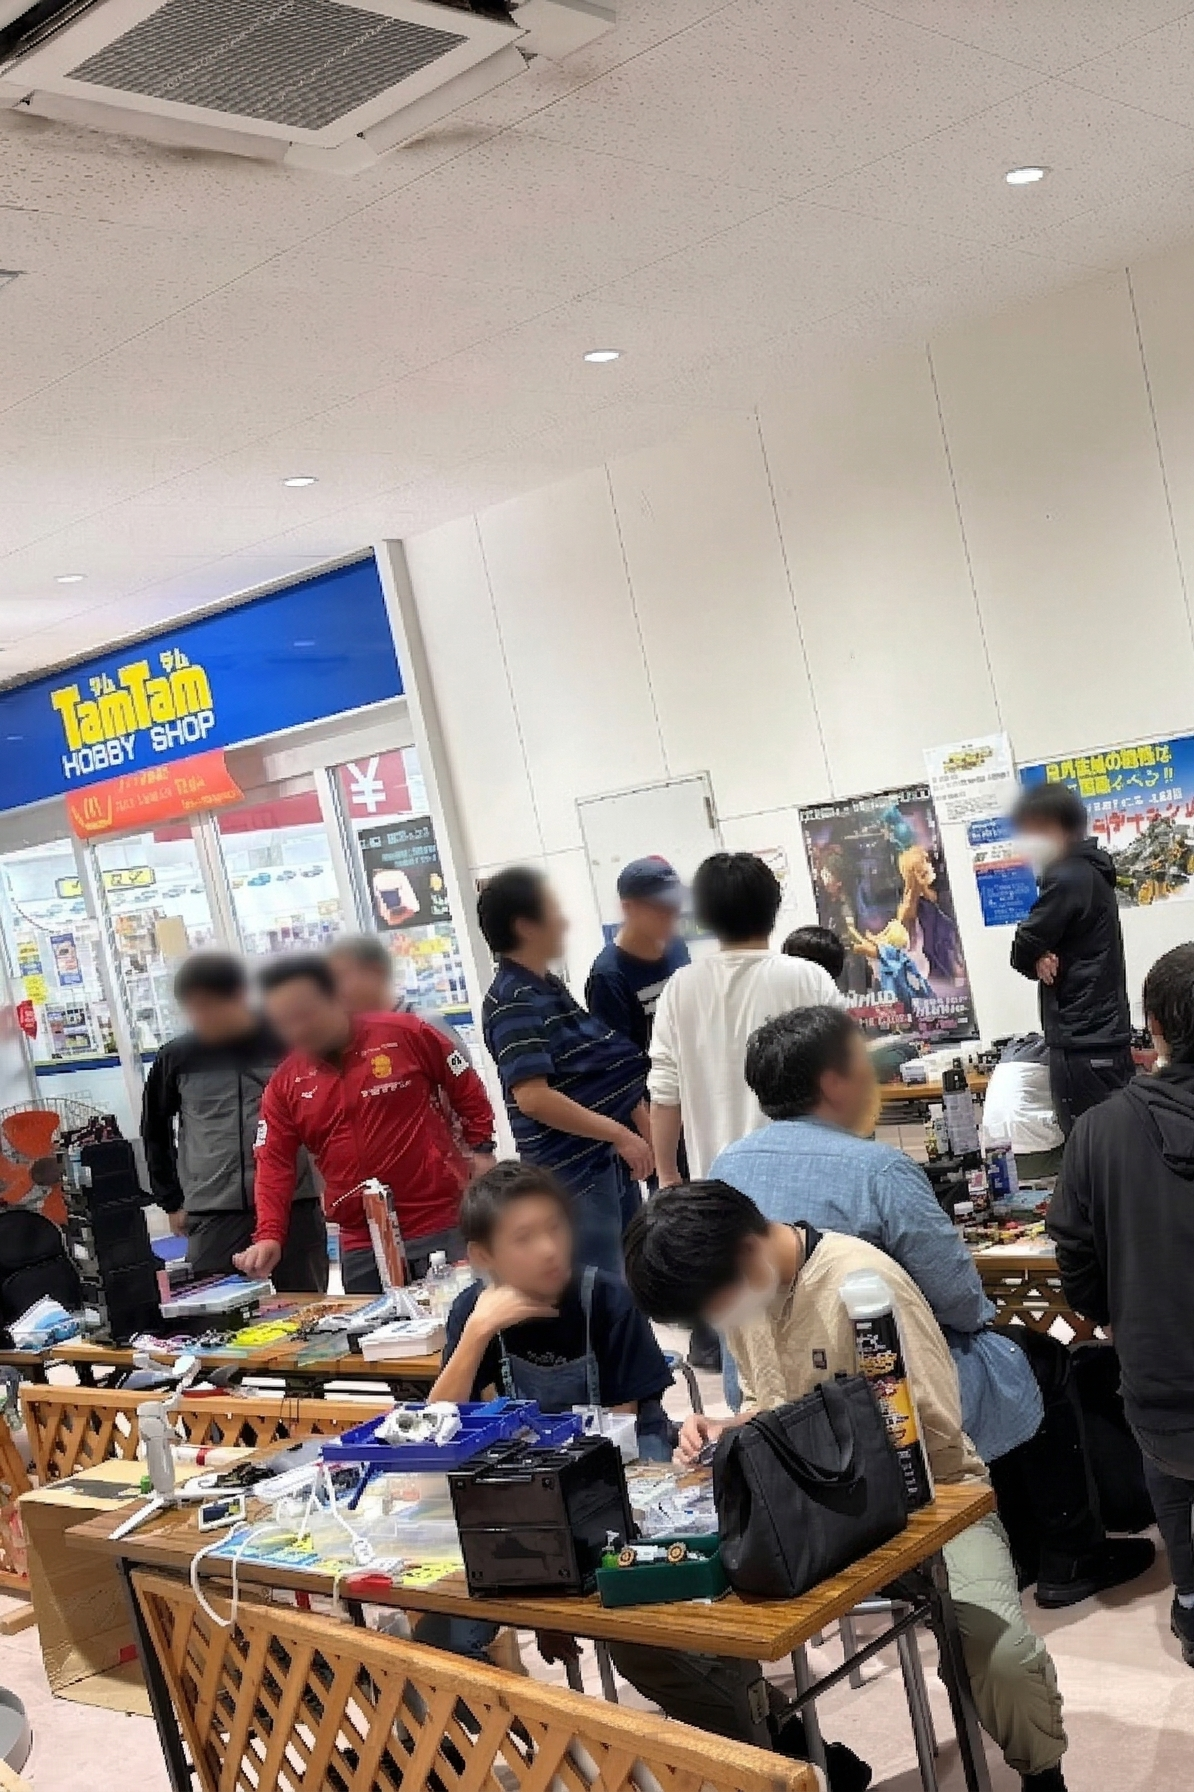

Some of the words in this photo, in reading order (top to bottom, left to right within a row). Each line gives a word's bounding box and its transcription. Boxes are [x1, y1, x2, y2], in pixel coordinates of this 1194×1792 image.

[51, 659, 214, 751] TamTam
[62, 734, 136, 779] HOBBY
[150, 710, 215, 751] SHOP
